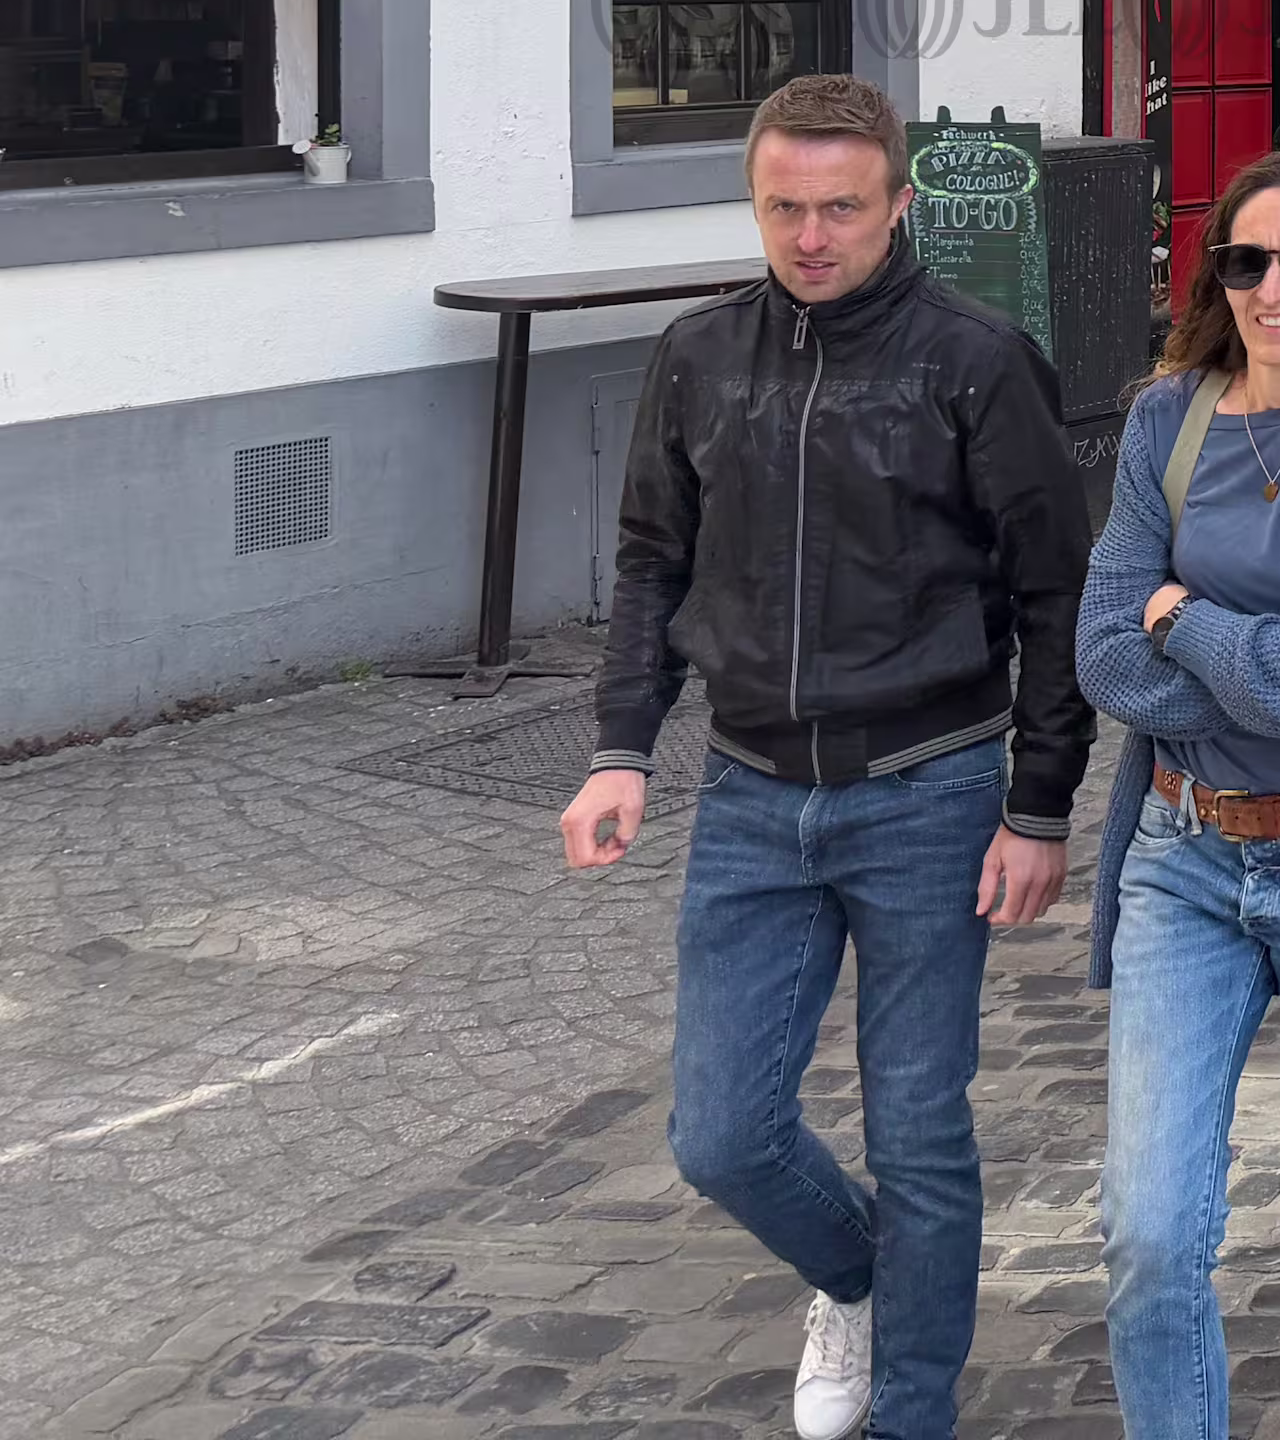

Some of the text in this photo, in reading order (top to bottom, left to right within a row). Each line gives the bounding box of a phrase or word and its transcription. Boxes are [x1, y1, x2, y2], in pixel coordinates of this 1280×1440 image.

[1144, 76, 1168, 98] like
[930, 150, 1007, 173] PIZZA
[946, 169, 1020, 191] COLOGNE!
[928, 197, 1018, 231] TO-GO
